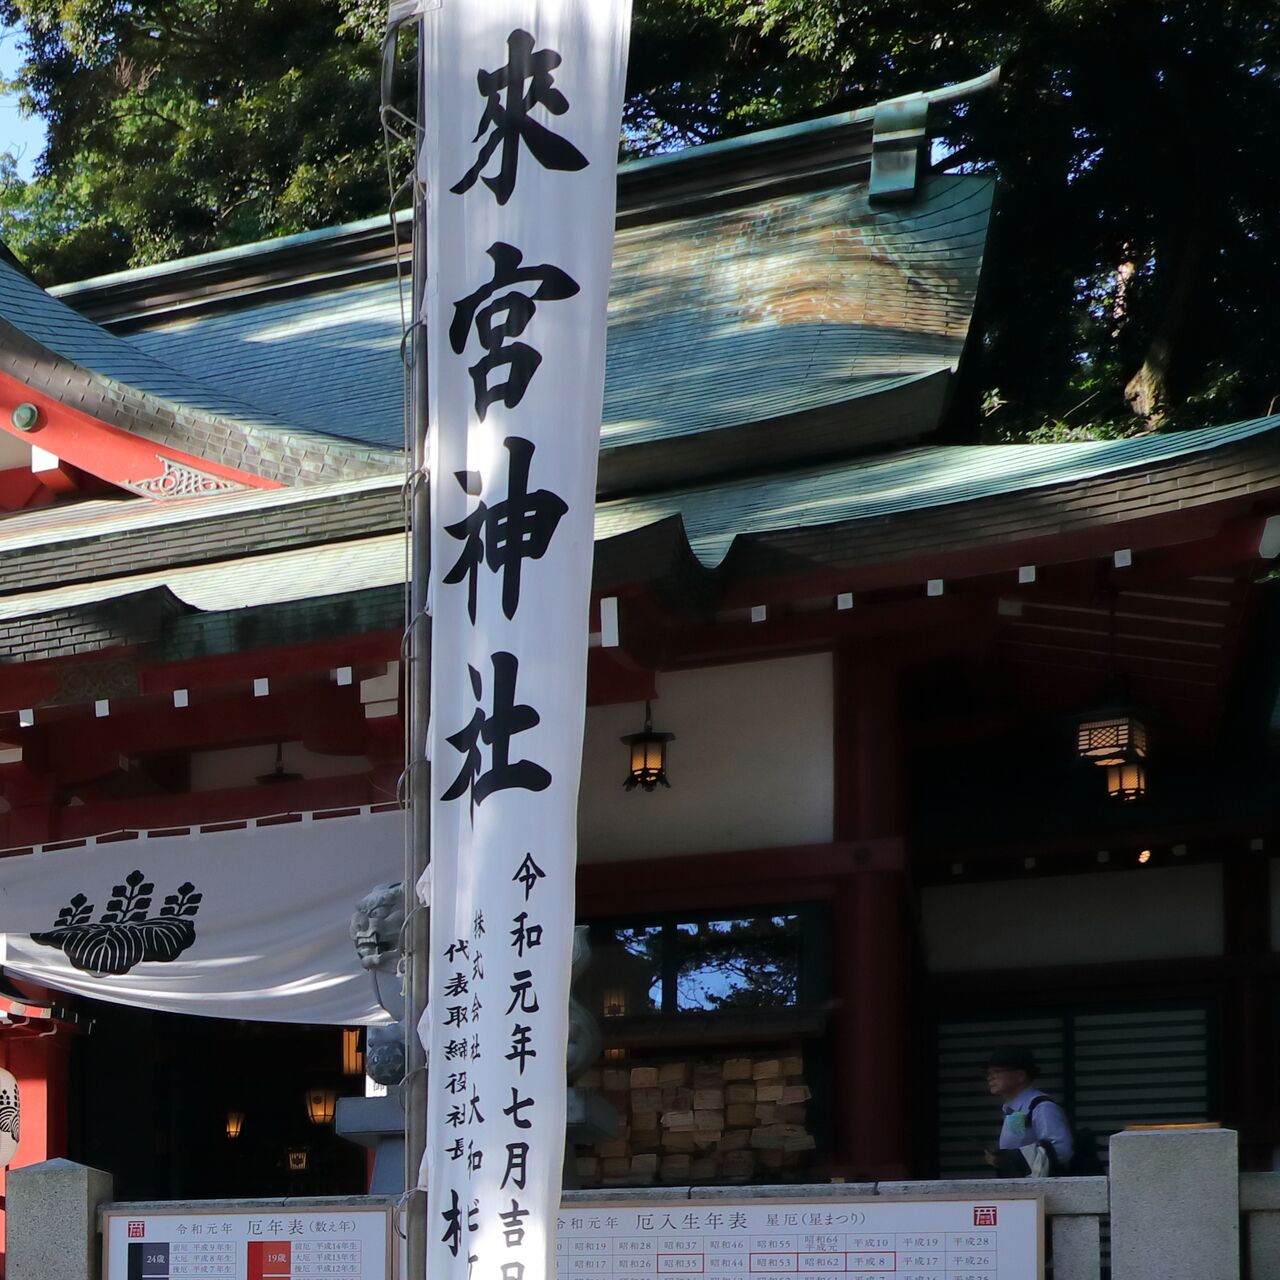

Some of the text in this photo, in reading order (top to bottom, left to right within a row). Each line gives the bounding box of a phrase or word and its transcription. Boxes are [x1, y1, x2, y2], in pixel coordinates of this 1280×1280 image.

[442, 938, 469, 1162] 代表取締役社長
[635, 1212, 748, 1230] 厄入生年表
[176, 1223, 233, 1235] 令和元年
[575, 1242, 606, 1250] 昭和19
[619, 1242, 651, 1250] 昭和28
[664, 1242, 697, 1250] 昭和37
[710, 1240, 744, 1248] 昭和46
[757, 1240, 790, 1248] 昭和55
[854, 1239, 888, 1247] 平成10
[903, 1238, 938, 1247] 平成19
[954, 1237, 989, 1246] 平成28
[146, 1255, 165, 1263] 24歳
[268, 1254, 287, 1263] 19歳
[575, 1257, 989, 1268] 昭和17 昭和26 昭和35 昭和44 昭和53 昭和62 平成8 平成17 平成26
